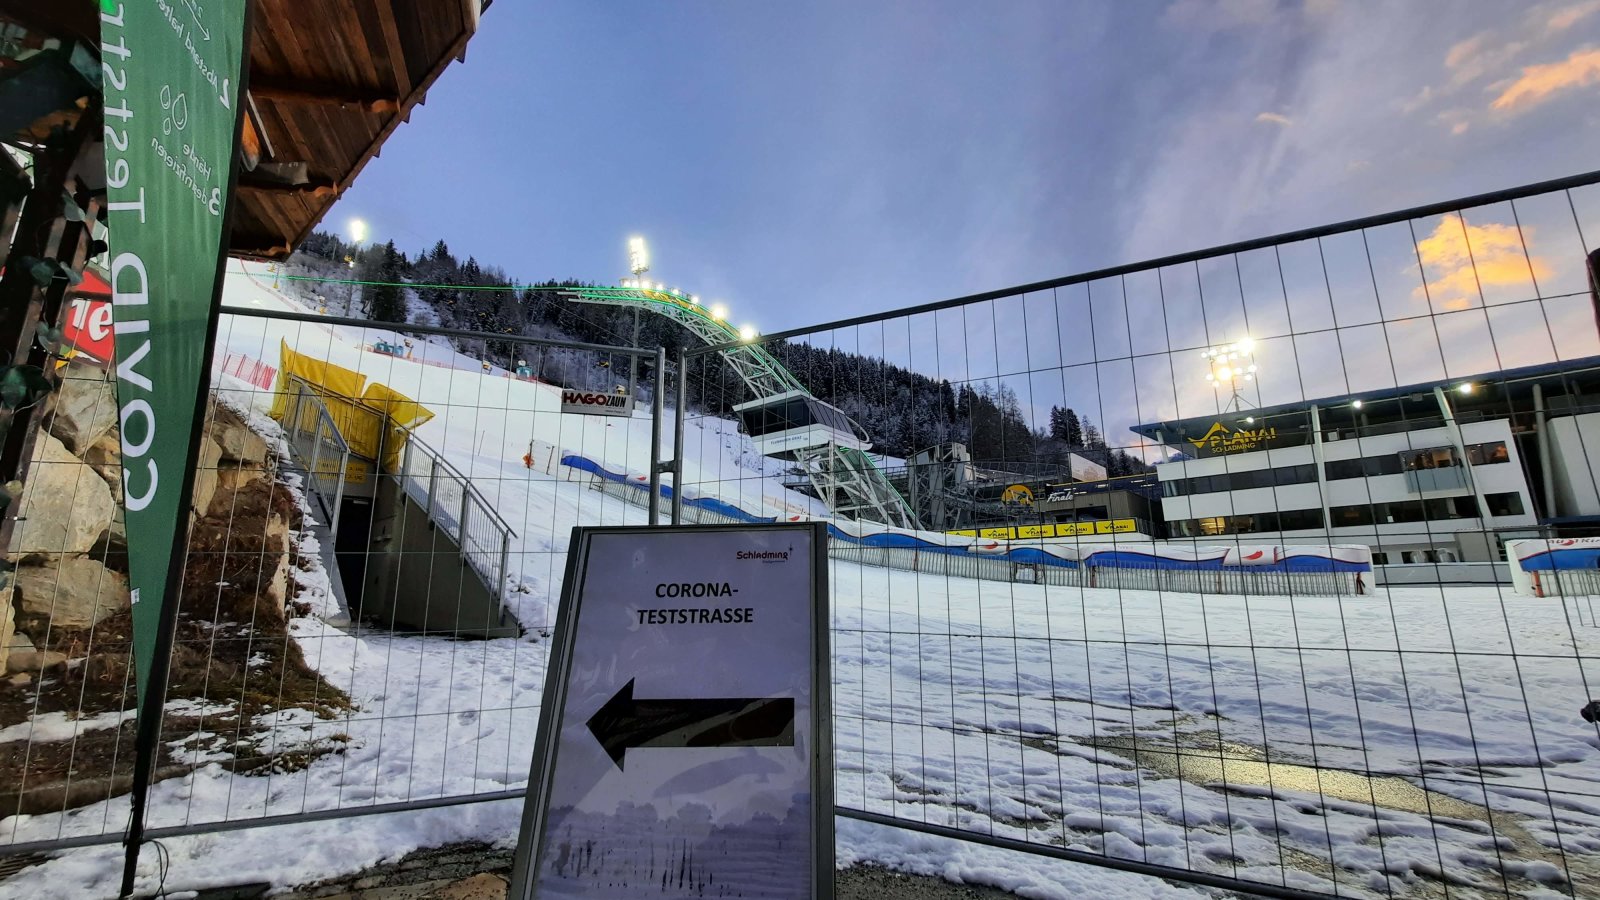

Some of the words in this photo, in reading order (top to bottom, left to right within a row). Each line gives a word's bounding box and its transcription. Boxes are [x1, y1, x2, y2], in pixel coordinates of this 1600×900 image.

[1210, 426, 1277, 447] PLANAI
[1046, 491, 1074, 503] Finale
[736, 550, 789, 560] Schladming
[655, 582, 739, 599] CORONA-
[636, 607, 754, 625] TESTSTRASSE
